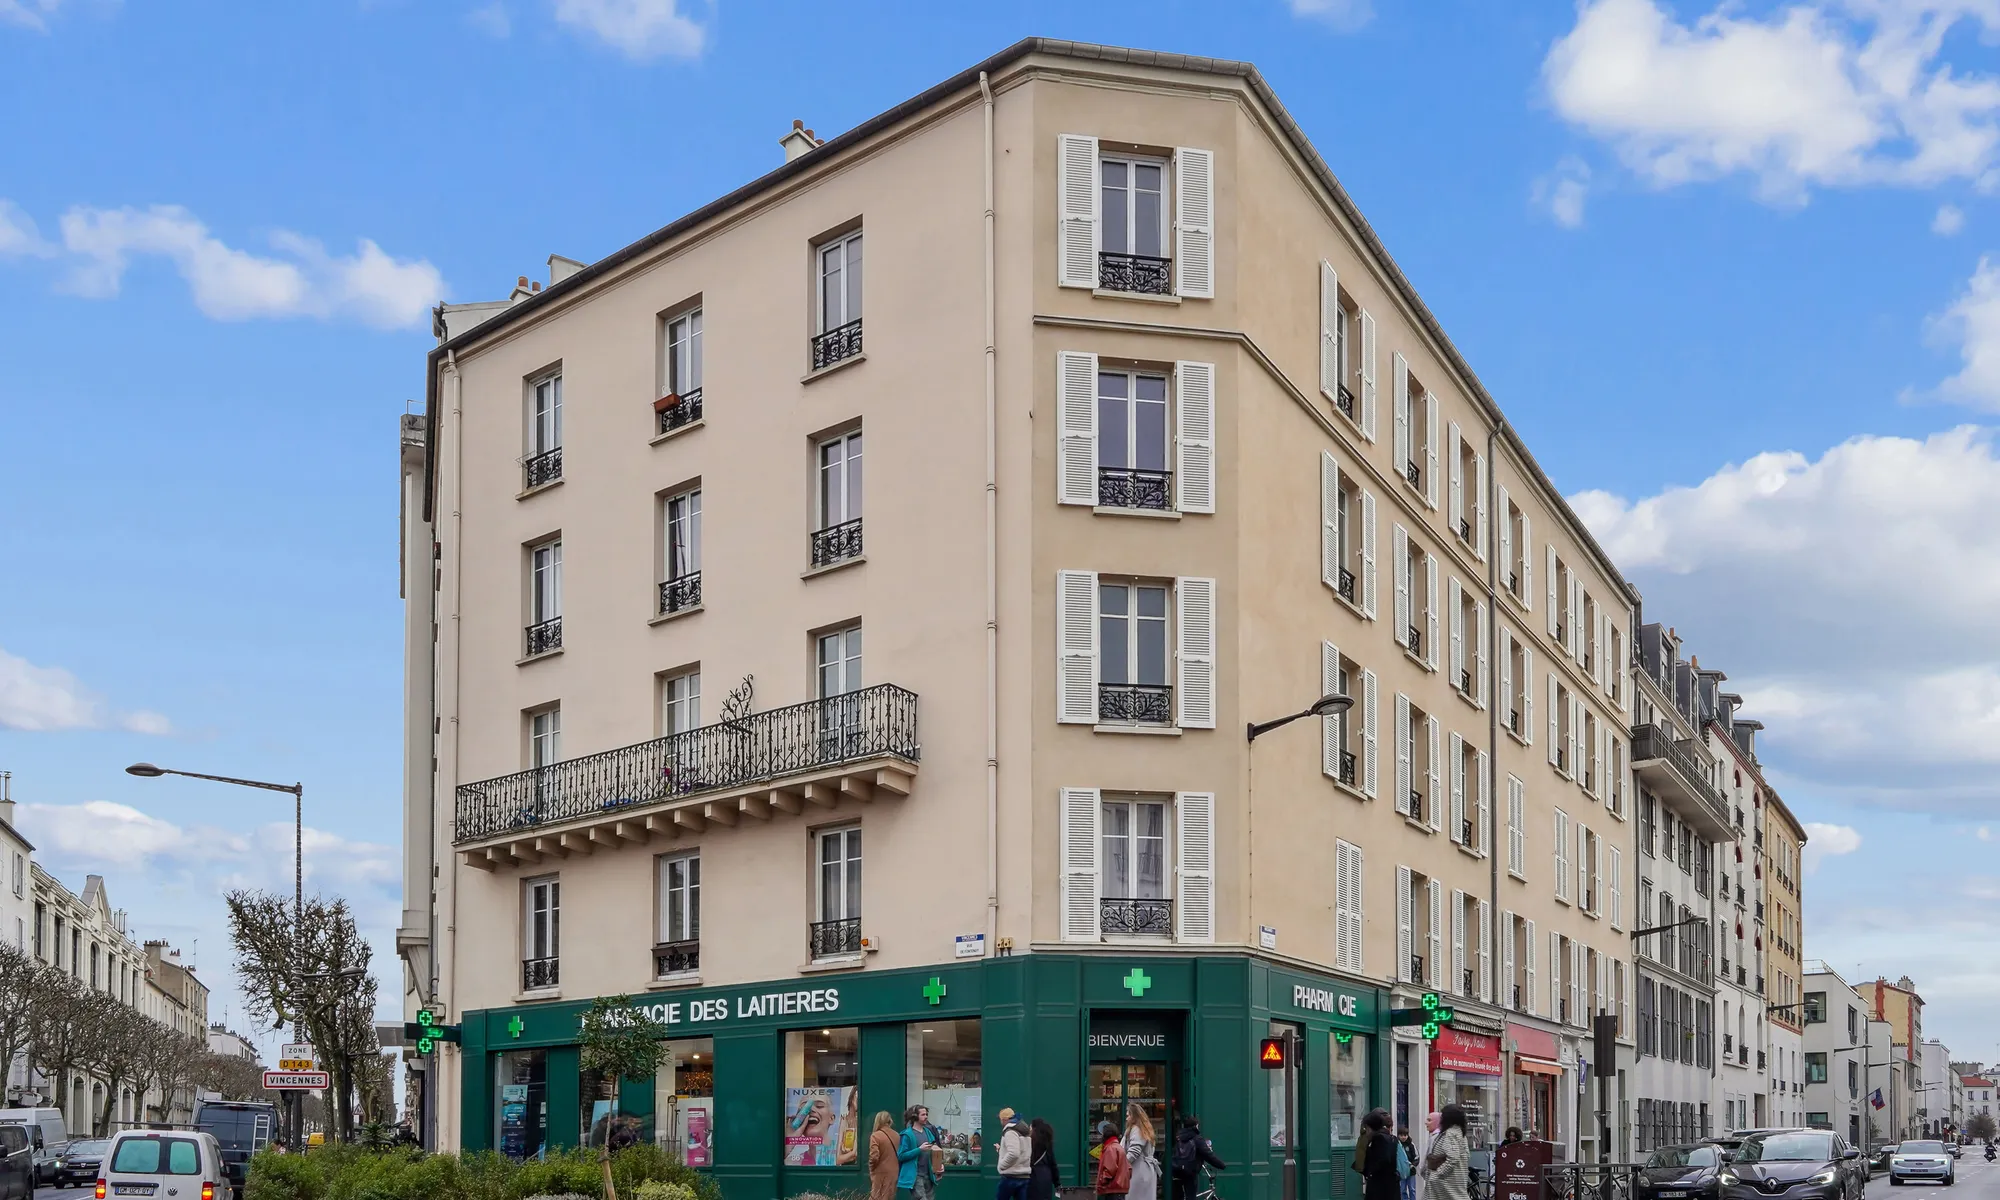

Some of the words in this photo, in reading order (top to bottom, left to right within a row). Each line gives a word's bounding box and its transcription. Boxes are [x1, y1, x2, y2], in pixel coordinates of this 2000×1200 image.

[690, 999, 728, 1021] DES
[738, 989, 840, 1018] LAITIERES
[1089, 1034, 1165, 1047] BIENVENUE
[1442, 1056, 1453, 1066] Salon
[1453, 1058, 1458, 1066] de
[269, 1076, 323, 1085] VINCENNES
[1509, 1192, 1527, 1200] Paris
